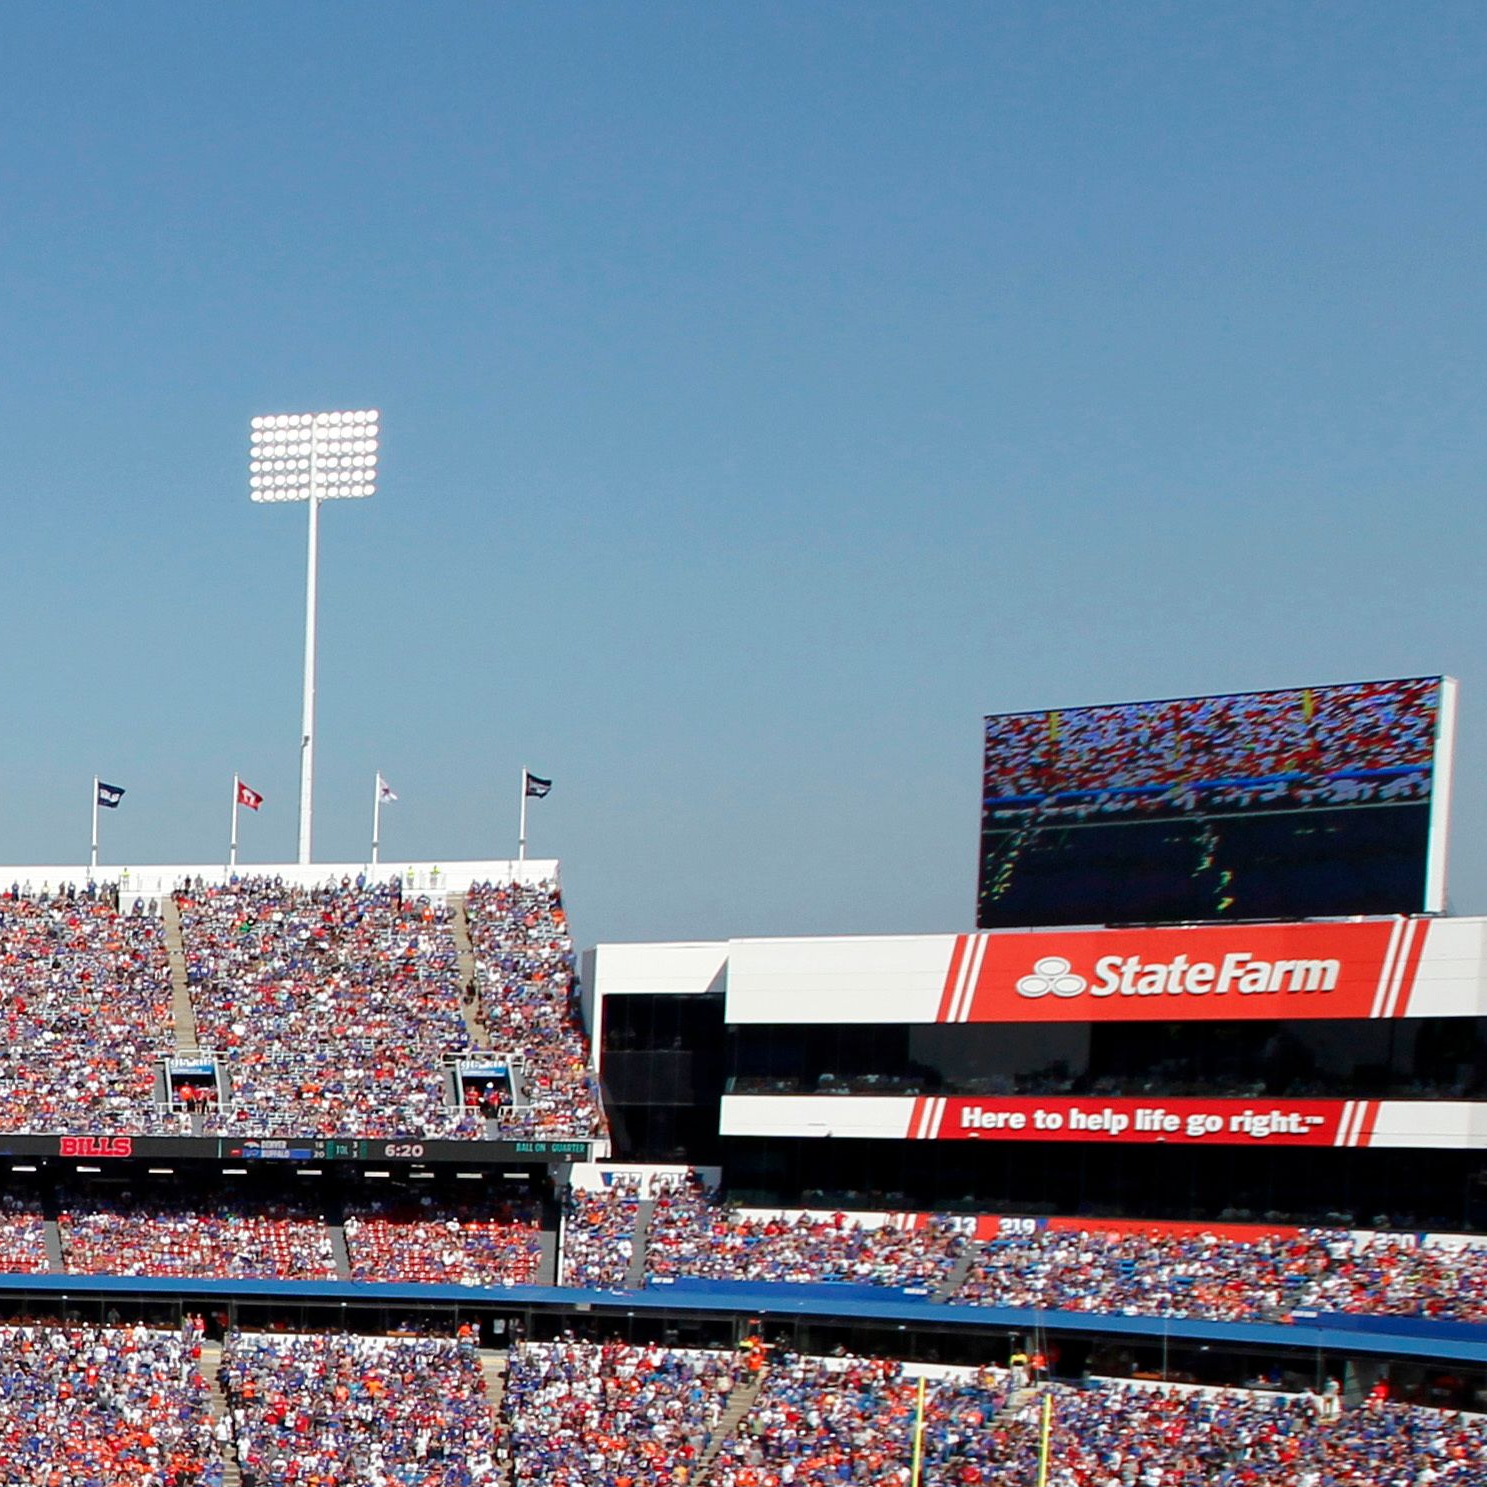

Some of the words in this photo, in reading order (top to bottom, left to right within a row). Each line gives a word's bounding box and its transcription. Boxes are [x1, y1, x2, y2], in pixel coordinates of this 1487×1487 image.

[961, 1107, 1026, 1130] Here
[1033, 1109, 1062, 1130] to
[1069, 1108, 1128, 1135] help
[1135, 1109, 1180, 1132] life
[1186, 1115, 1223, 1136] go
[60, 1137, 132, 1157] BILLS
[384, 1144, 424, 1158] 6:20
[516, 1143, 534, 1152] BALL
[535, 1143, 546, 1152] ON
[552, 1144, 586, 1153] QUARTER
